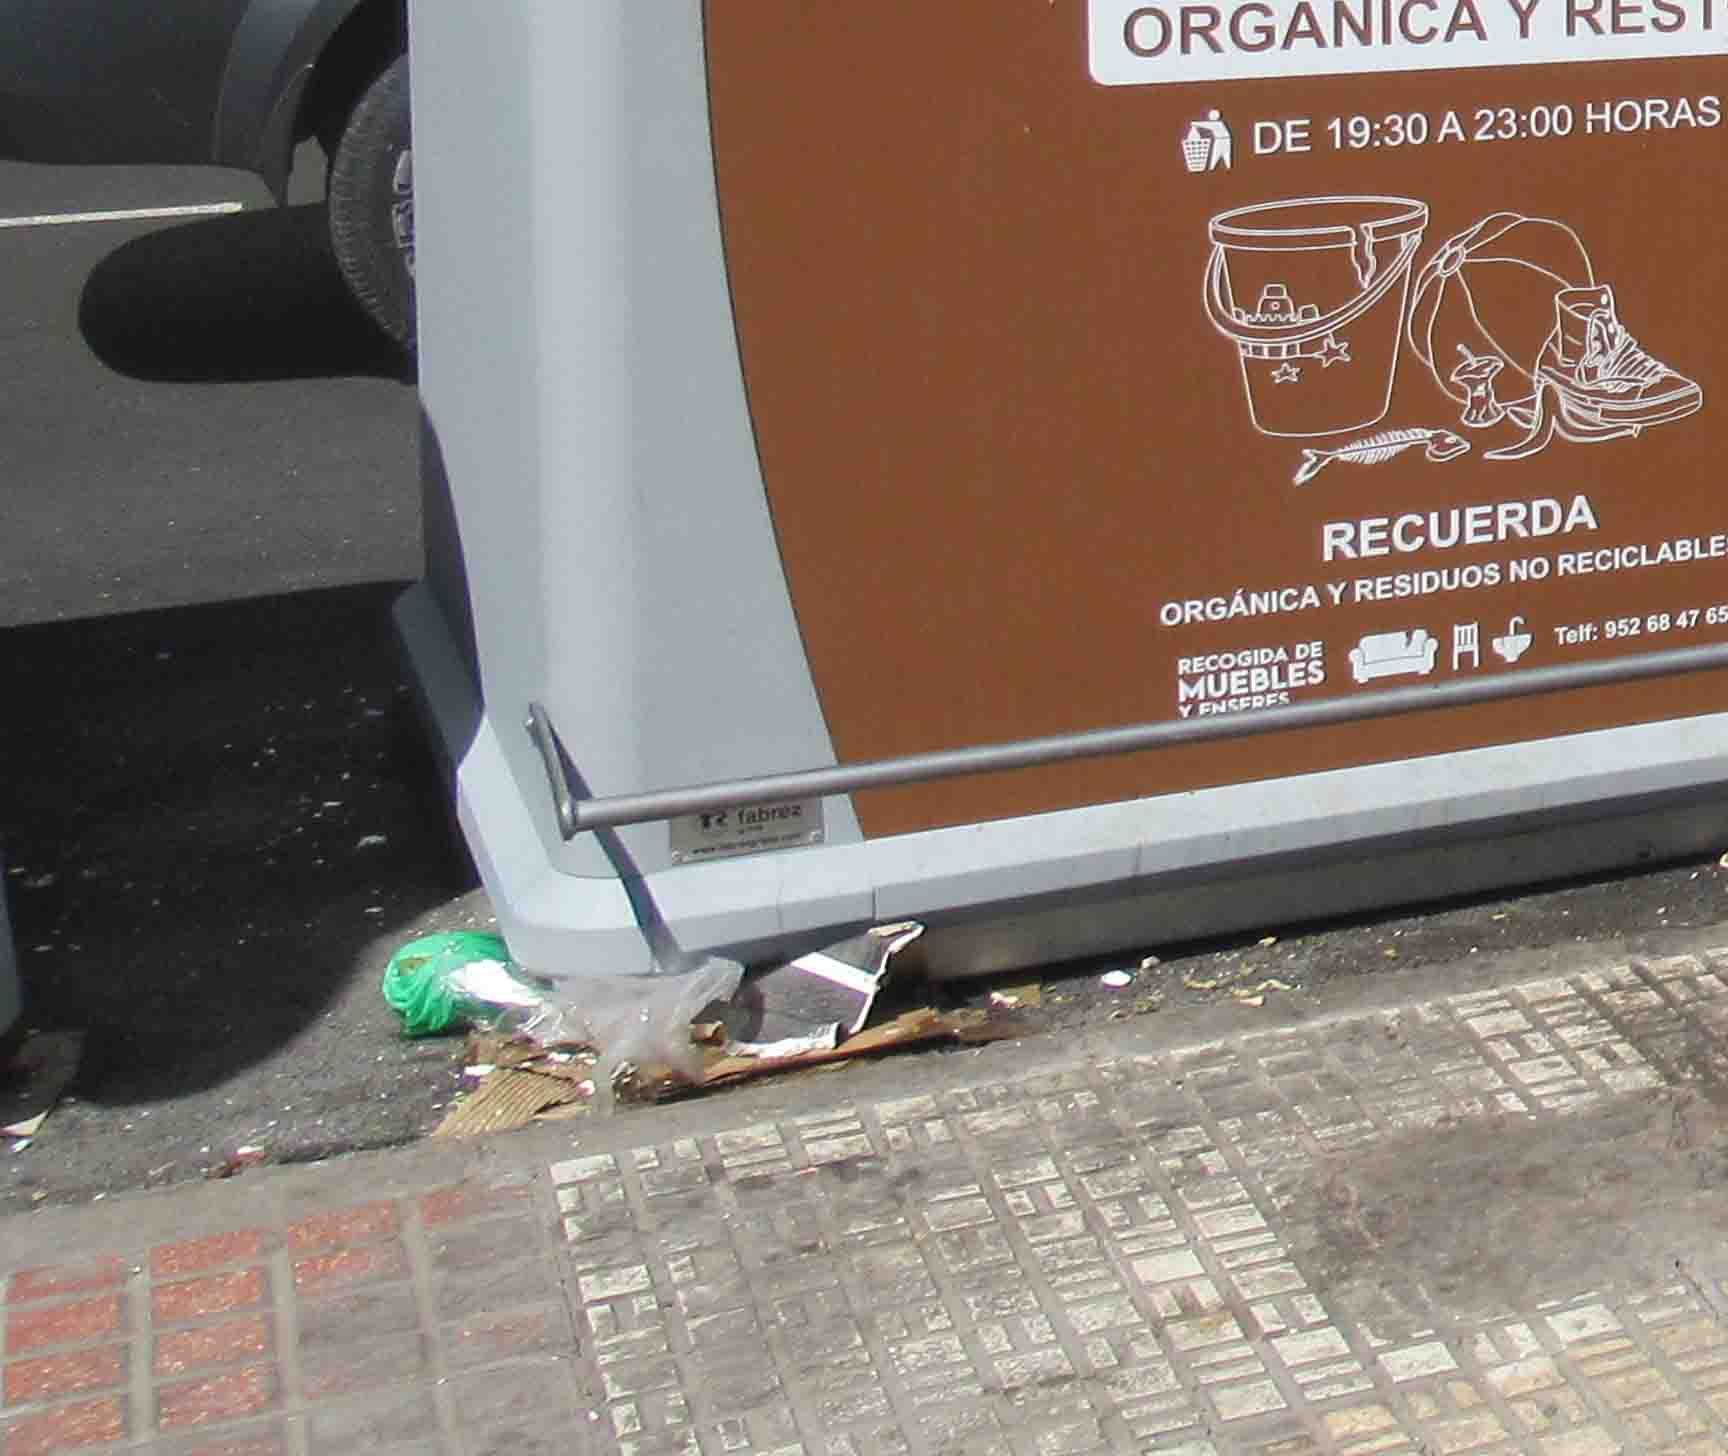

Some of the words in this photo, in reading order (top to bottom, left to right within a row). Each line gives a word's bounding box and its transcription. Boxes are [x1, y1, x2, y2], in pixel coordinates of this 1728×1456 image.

[1254, 119, 1311, 155] DE
[1326, 113, 1429, 149] 19:30
[1438, 112, 1465, 143] A
[1474, 105, 1572, 142] 23:00
[1586, 95, 1722, 134] HORAS
[1321, 494, 1598, 561] RECUERDA
[1159, 587, 1320, 627] ORGÁNICA
[1327, 583, 1347, 606] Y
[1353, 562, 1501, 602] RESIDUOS
[1508, 558, 1550, 583] NO
[1553, 622, 1599, 646] Telf:
[1604, 616, 1640, 640] 952
[1647, 613, 1669, 633] 68
[1676, 609, 1699, 628] 47
[1705, 606, 1728, 624] 65
[1178, 647, 1289, 674] RECOGIDA
[1296, 641, 1323, 659] DE
[1178, 660, 1325, 702] MUEBLES
[1179, 704, 1193, 718] Y
